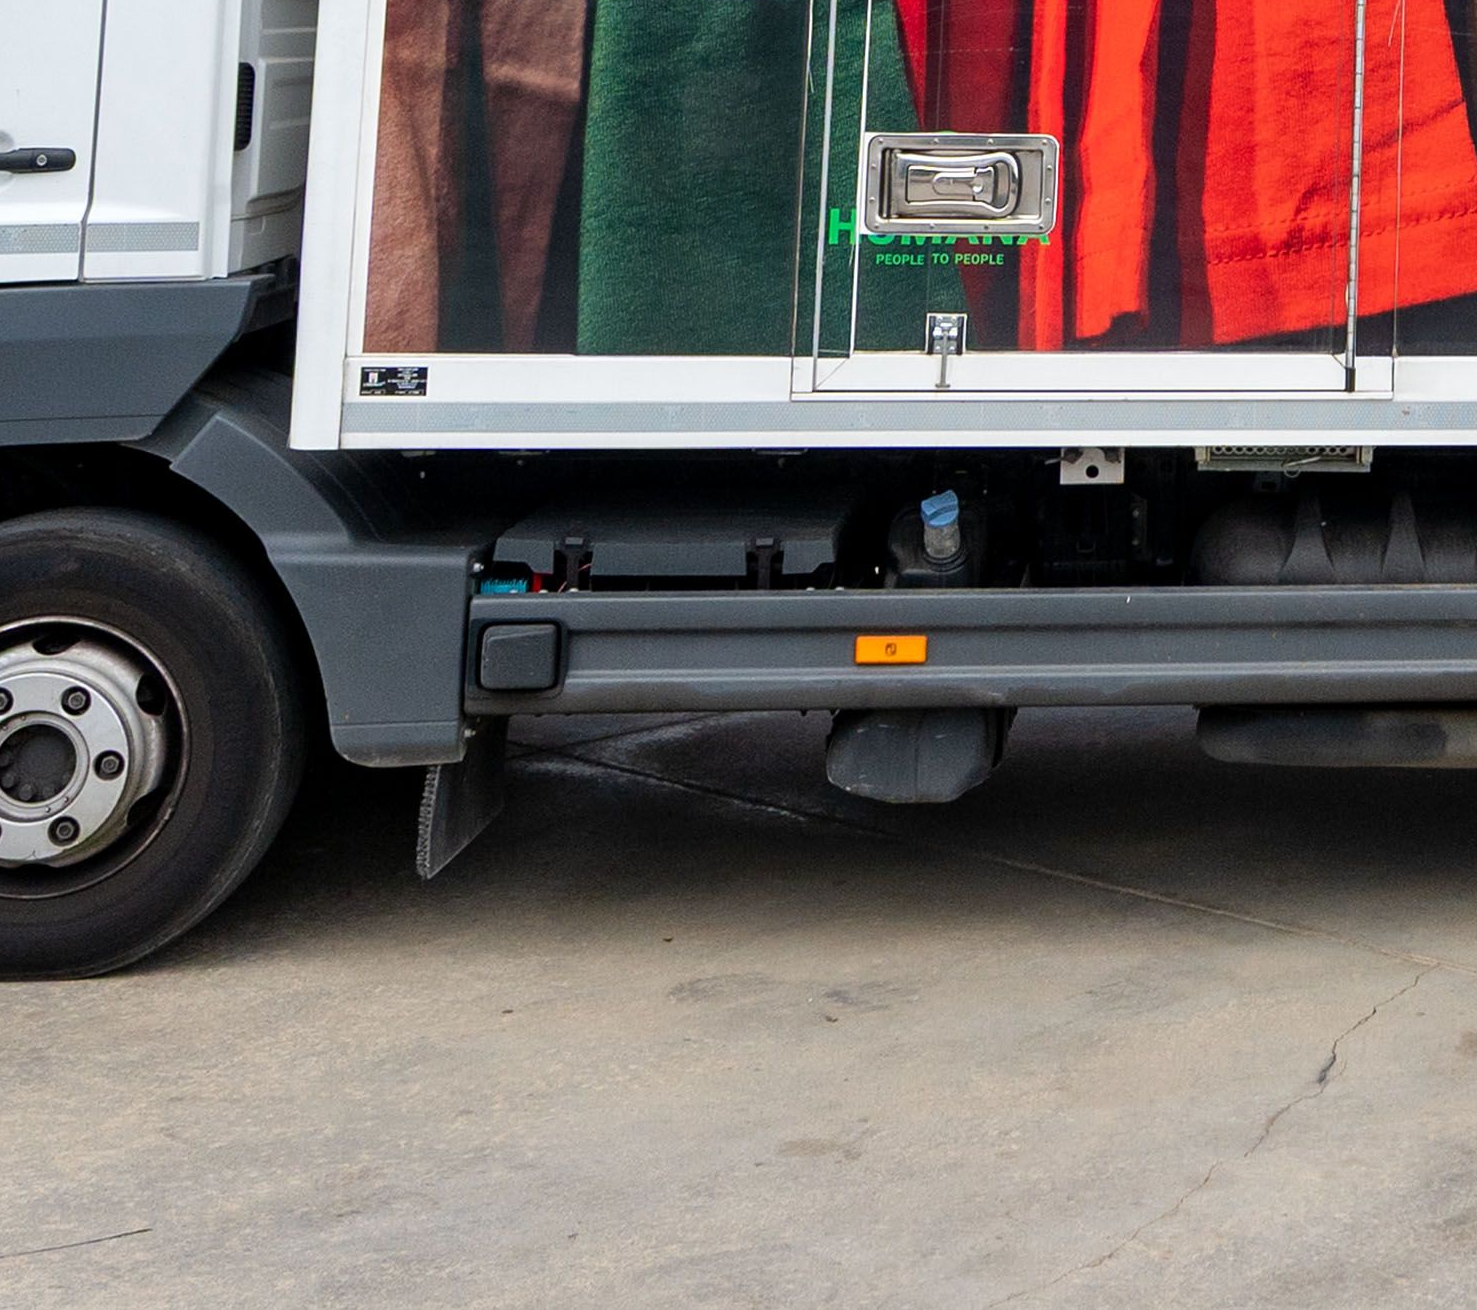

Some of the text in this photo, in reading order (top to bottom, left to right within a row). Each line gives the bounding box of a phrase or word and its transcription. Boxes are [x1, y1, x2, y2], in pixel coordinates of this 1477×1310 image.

[876, 253, 1004, 265] PEOPLE TO PEOPLE
